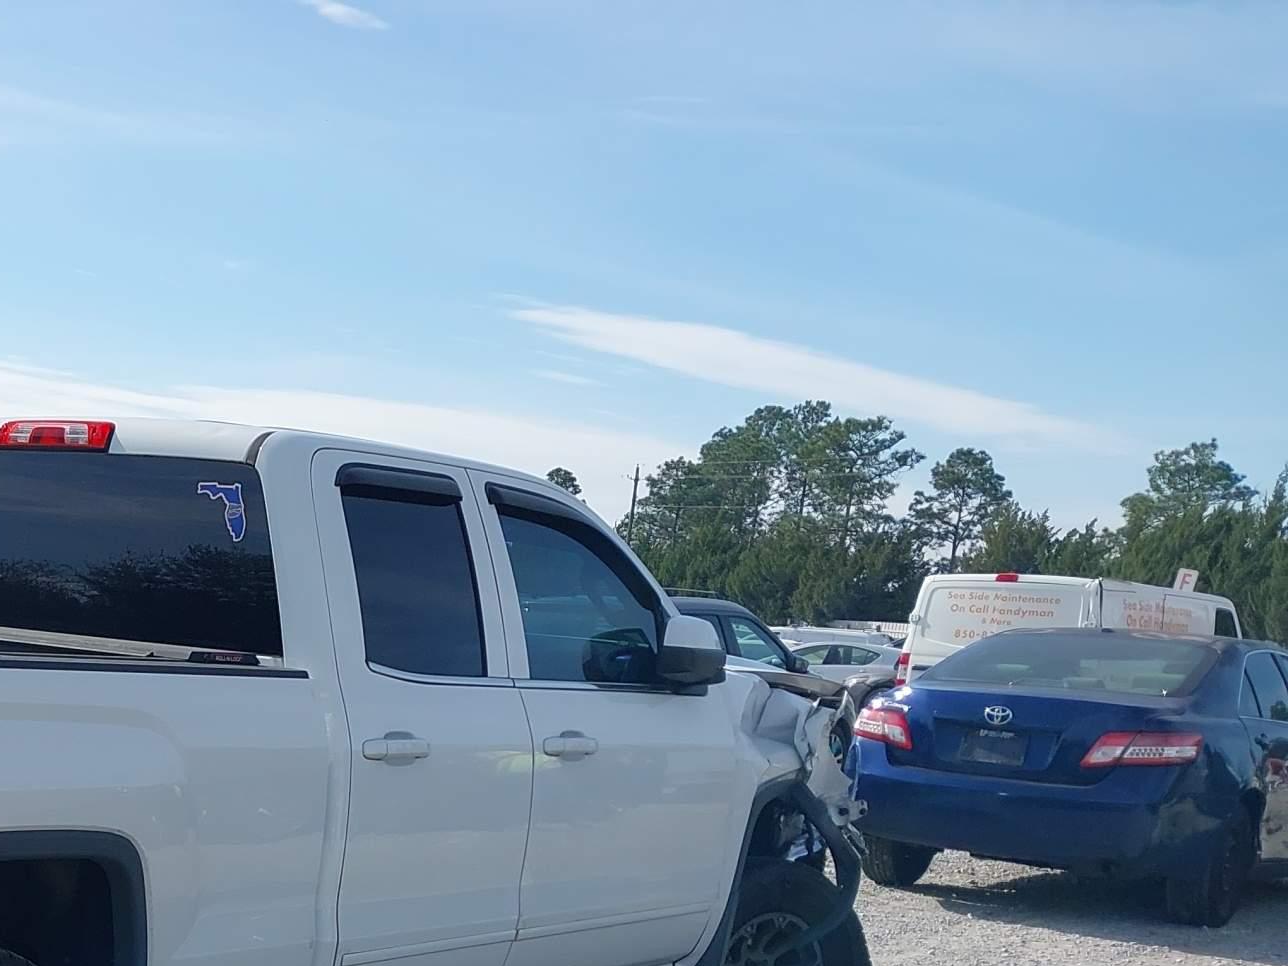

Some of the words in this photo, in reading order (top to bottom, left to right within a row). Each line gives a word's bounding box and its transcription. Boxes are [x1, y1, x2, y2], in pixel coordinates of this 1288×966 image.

[1180, 573, 1192, 590] F
[947, 591, 966, 600] Sea
[968, 592, 990, 601] Side
[993, 592, 1062, 605] Maintenance
[950, 603, 966, 613] On
[968, 604, 990, 614] Call
